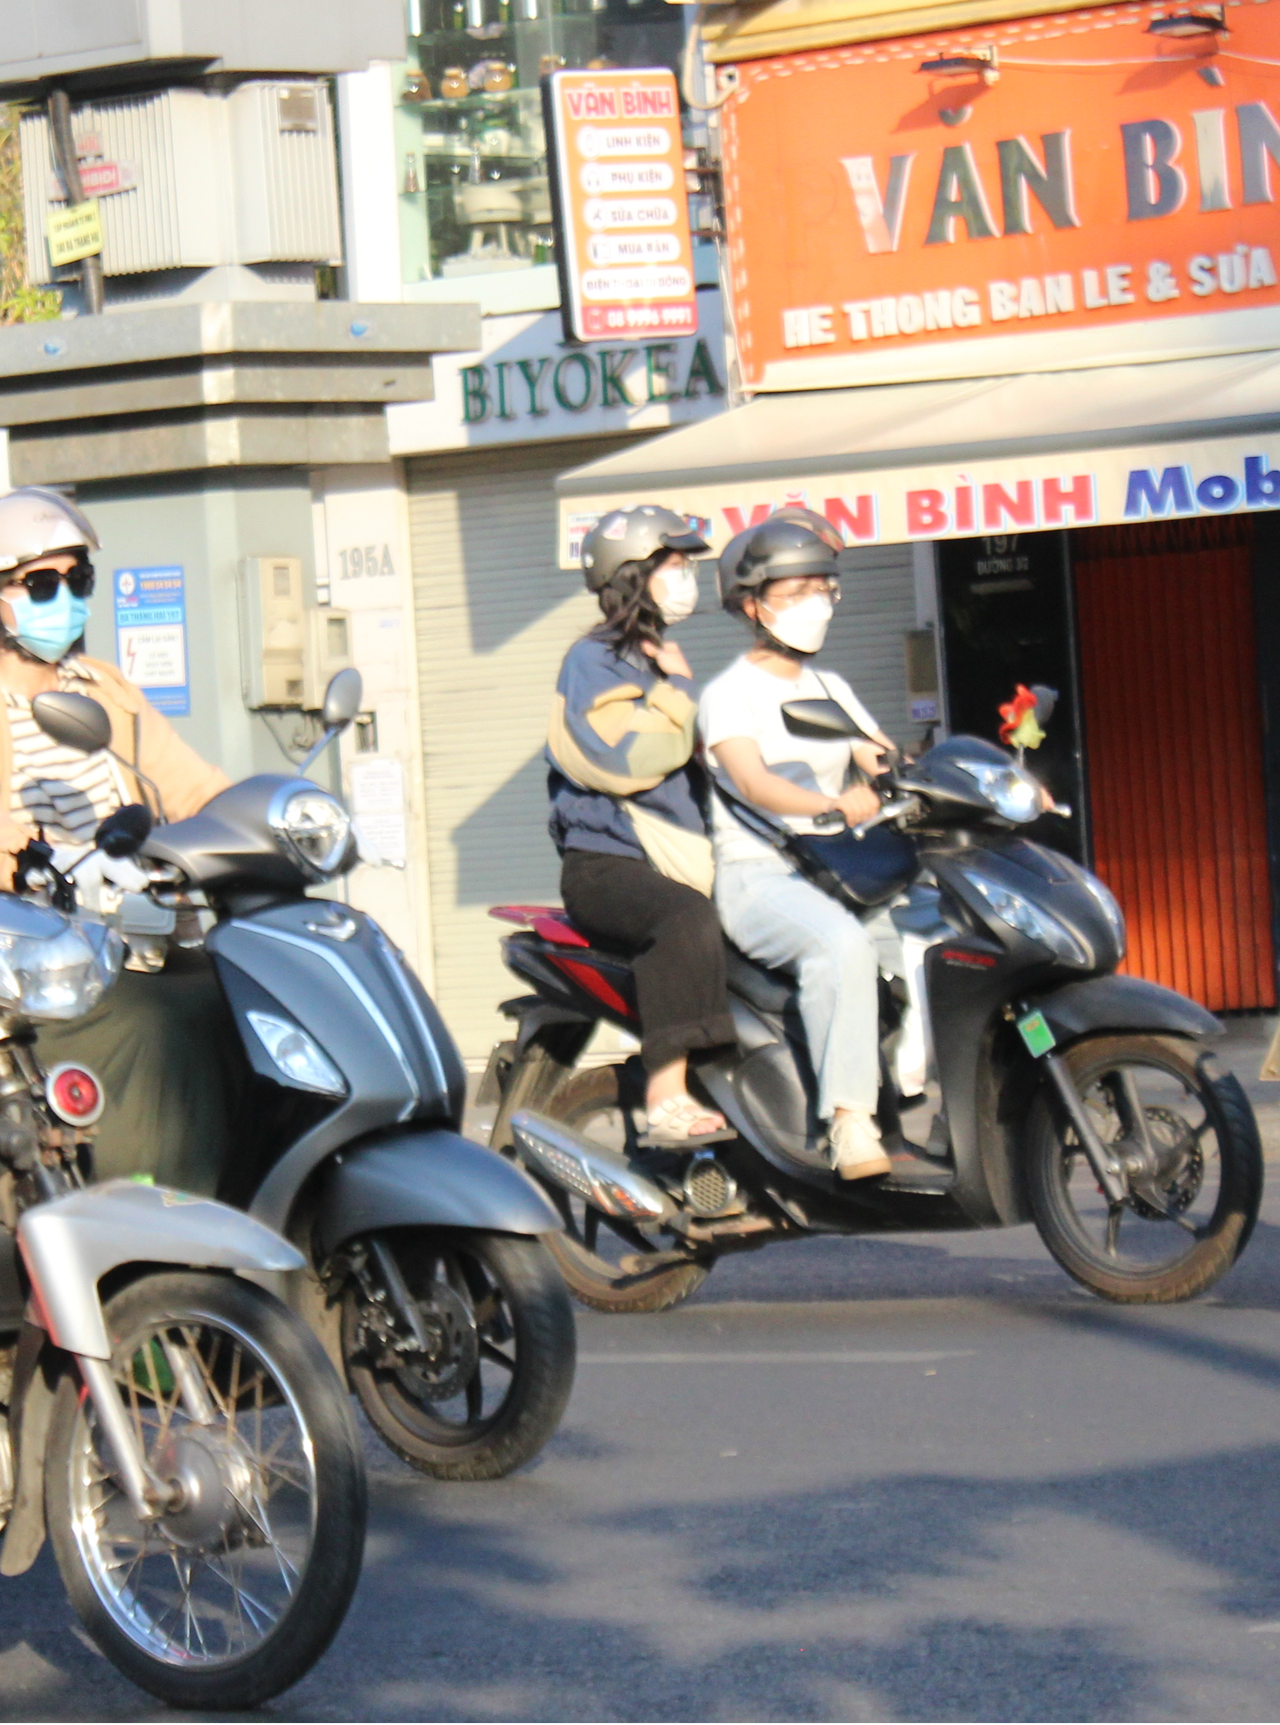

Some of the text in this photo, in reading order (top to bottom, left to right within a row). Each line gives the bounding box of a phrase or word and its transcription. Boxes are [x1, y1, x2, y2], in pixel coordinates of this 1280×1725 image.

[566, 80, 674, 119] VĂN BÌNH
[839, 105, 1080, 255] VĂN
[783, 306, 837, 349] HE
[843, 288, 982, 341] THONG
[988, 272, 1077, 323] BAN
[1082, 265, 1135, 310] LE
[1146, 261, 1180, 303] &
[460, 337, 725, 426] BIYOKEA
[905, 474, 1097, 537] BÌNH
[339, 544, 395, 580] 195A
